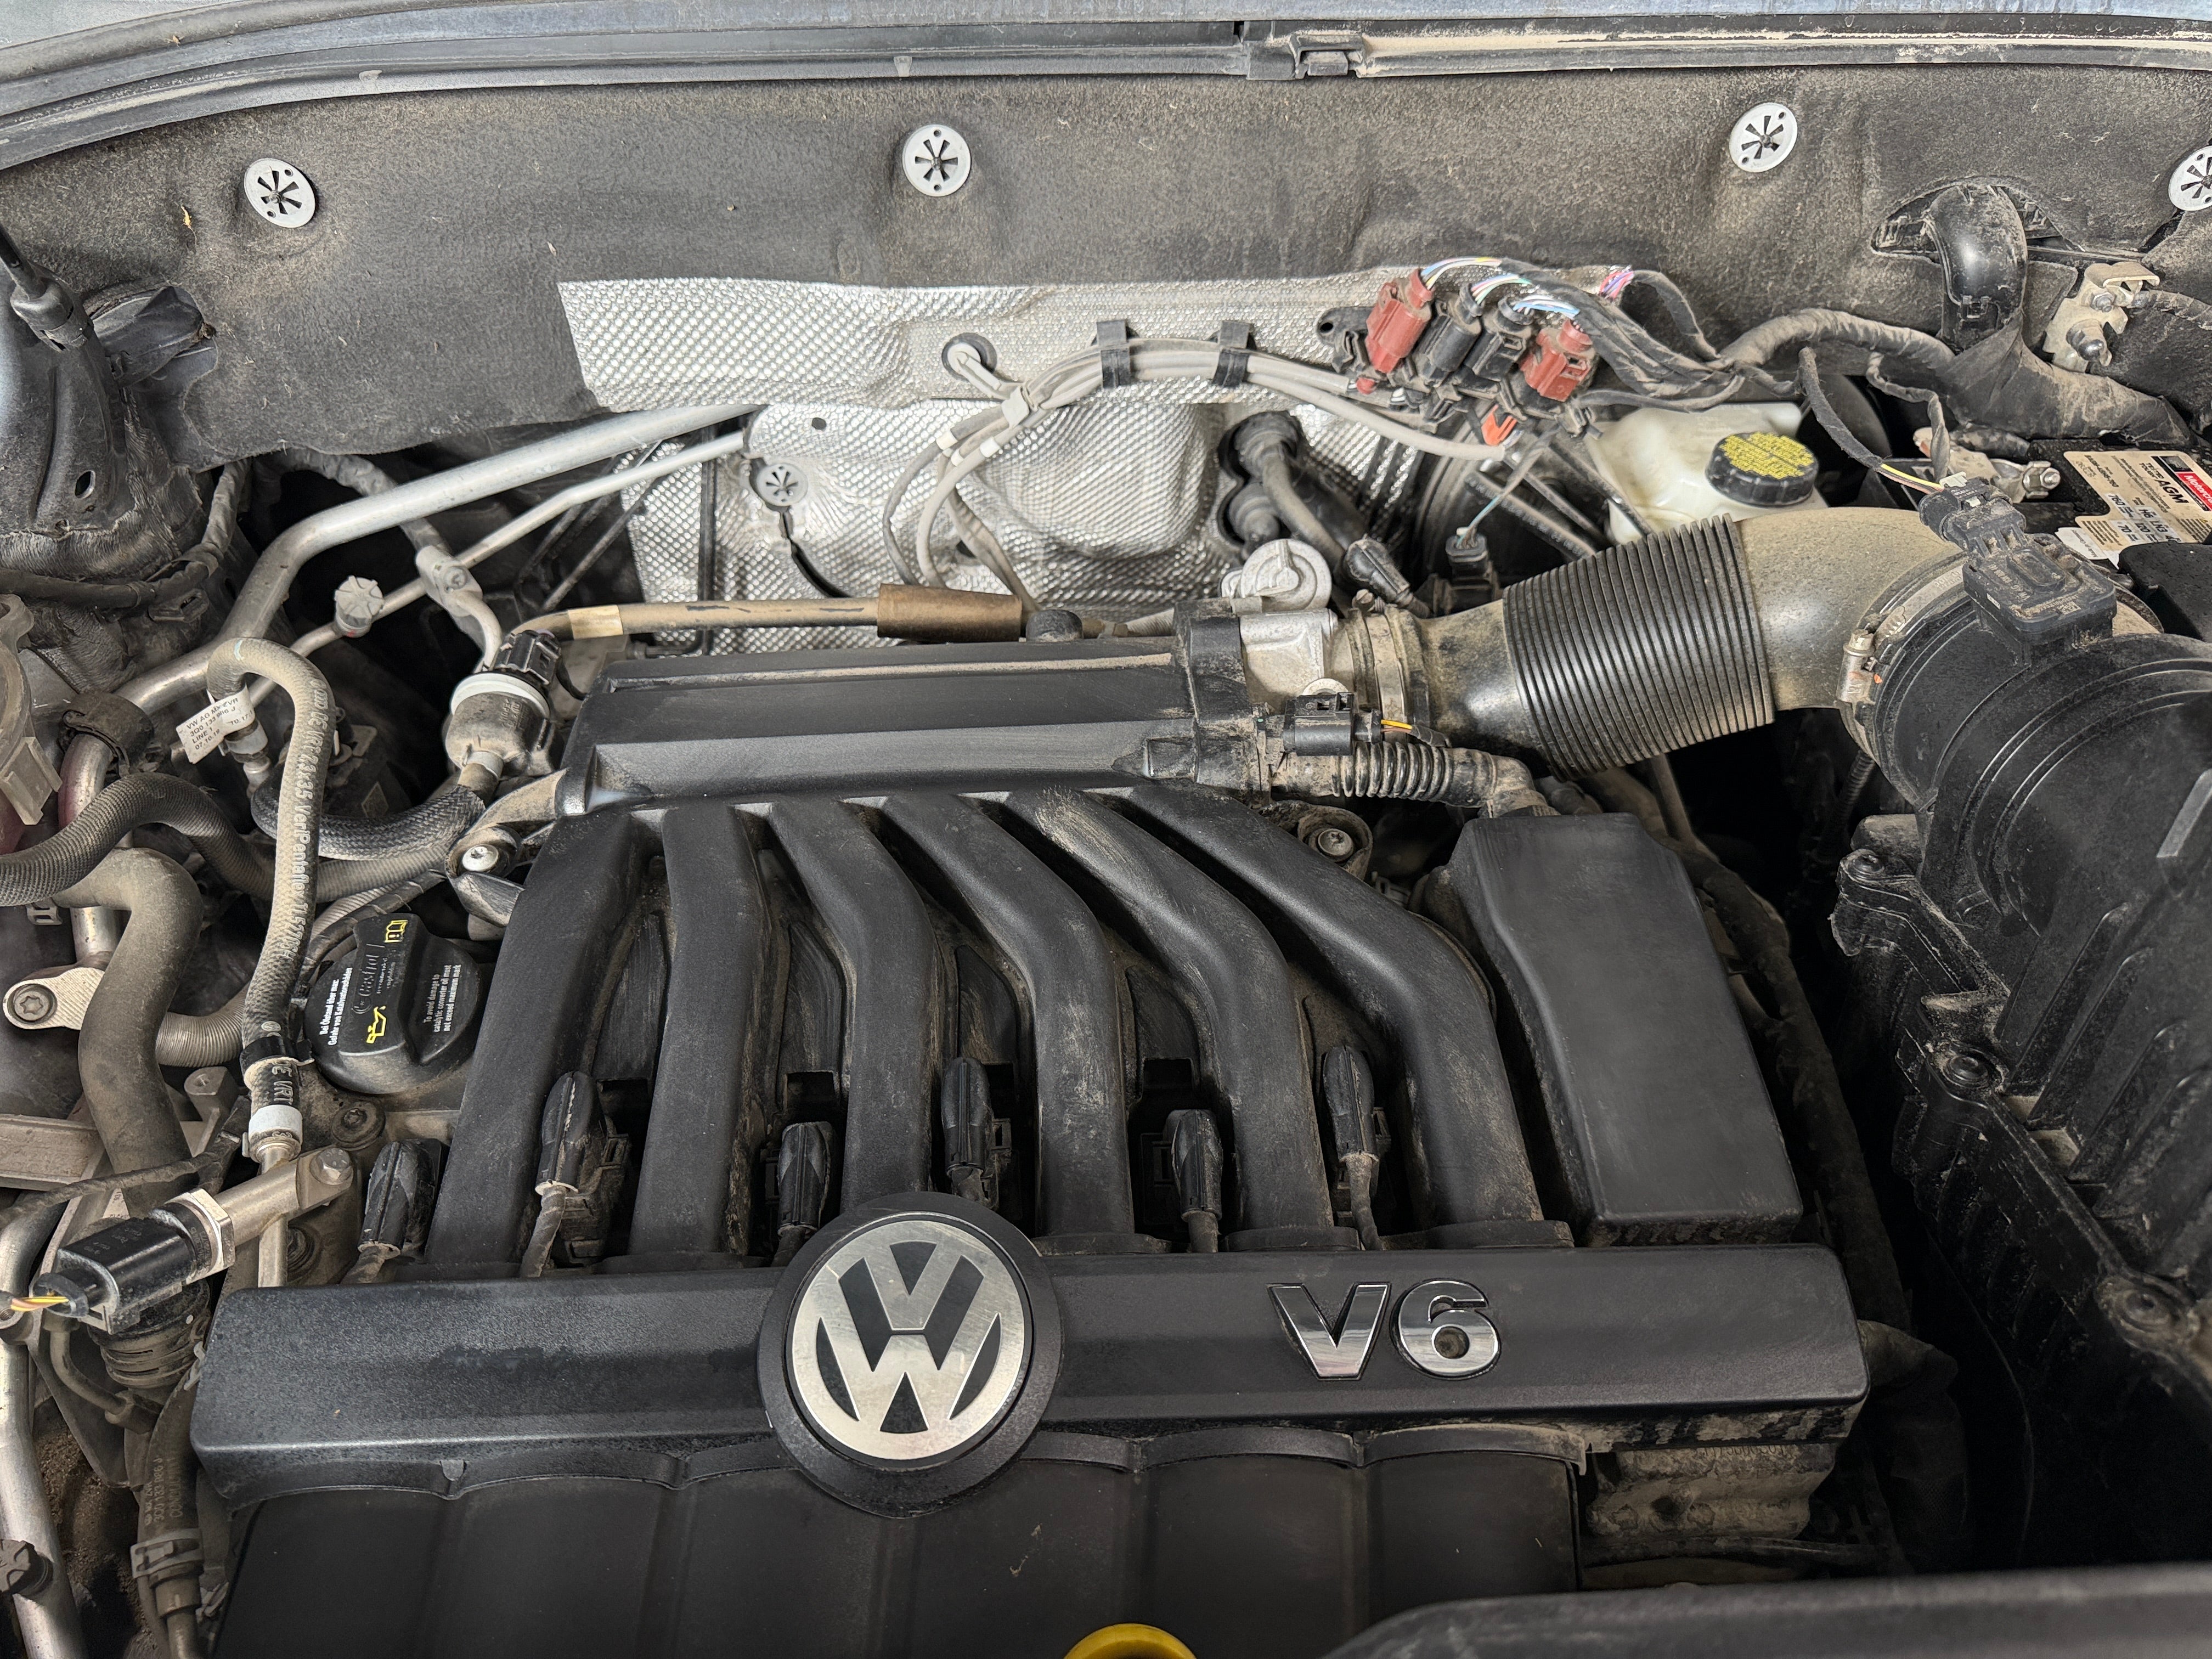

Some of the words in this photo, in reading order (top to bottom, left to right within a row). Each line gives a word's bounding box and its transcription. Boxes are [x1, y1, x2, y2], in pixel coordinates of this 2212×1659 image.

[2108, 494, 2126, 506] 760
[2154, 479, 2190, 503] AGM
[2118, 524, 2132, 533] 70
[2135, 522, 2151, 533] 120
[2138, 509, 2154, 518] H6
[2149, 521, 2168, 532] LN3
[187, 719, 198, 730] VW
[200, 714, 210, 722] AG
[189, 725, 204, 737] 3Q0
[205, 716, 217, 727] 133
[192, 730, 208, 744] LINE
[443, 964, 452, 978] must
[452, 964, 461, 978] mark
[326, 992, 337, 1005] über
[427, 980, 440, 1001] damage
[438, 985, 448, 1009] converter
[448, 978, 459, 1003] maximum
[319, 1005, 334, 1025] Ölstand
[426, 1001, 435, 1015] avoid
[445, 1003, 455, 1022] exceed
[319, 1025, 329, 1035] Bei
[433, 1009, 444, 1032] catalytic
[443, 1022, 452, 1031] not
[328, 1026, 340, 1046] Gefahr
[334, 1015, 342, 1027] von
[273, 1080, 294, 1105] VRT
[1267, 1278, 1502, 1381] V6
